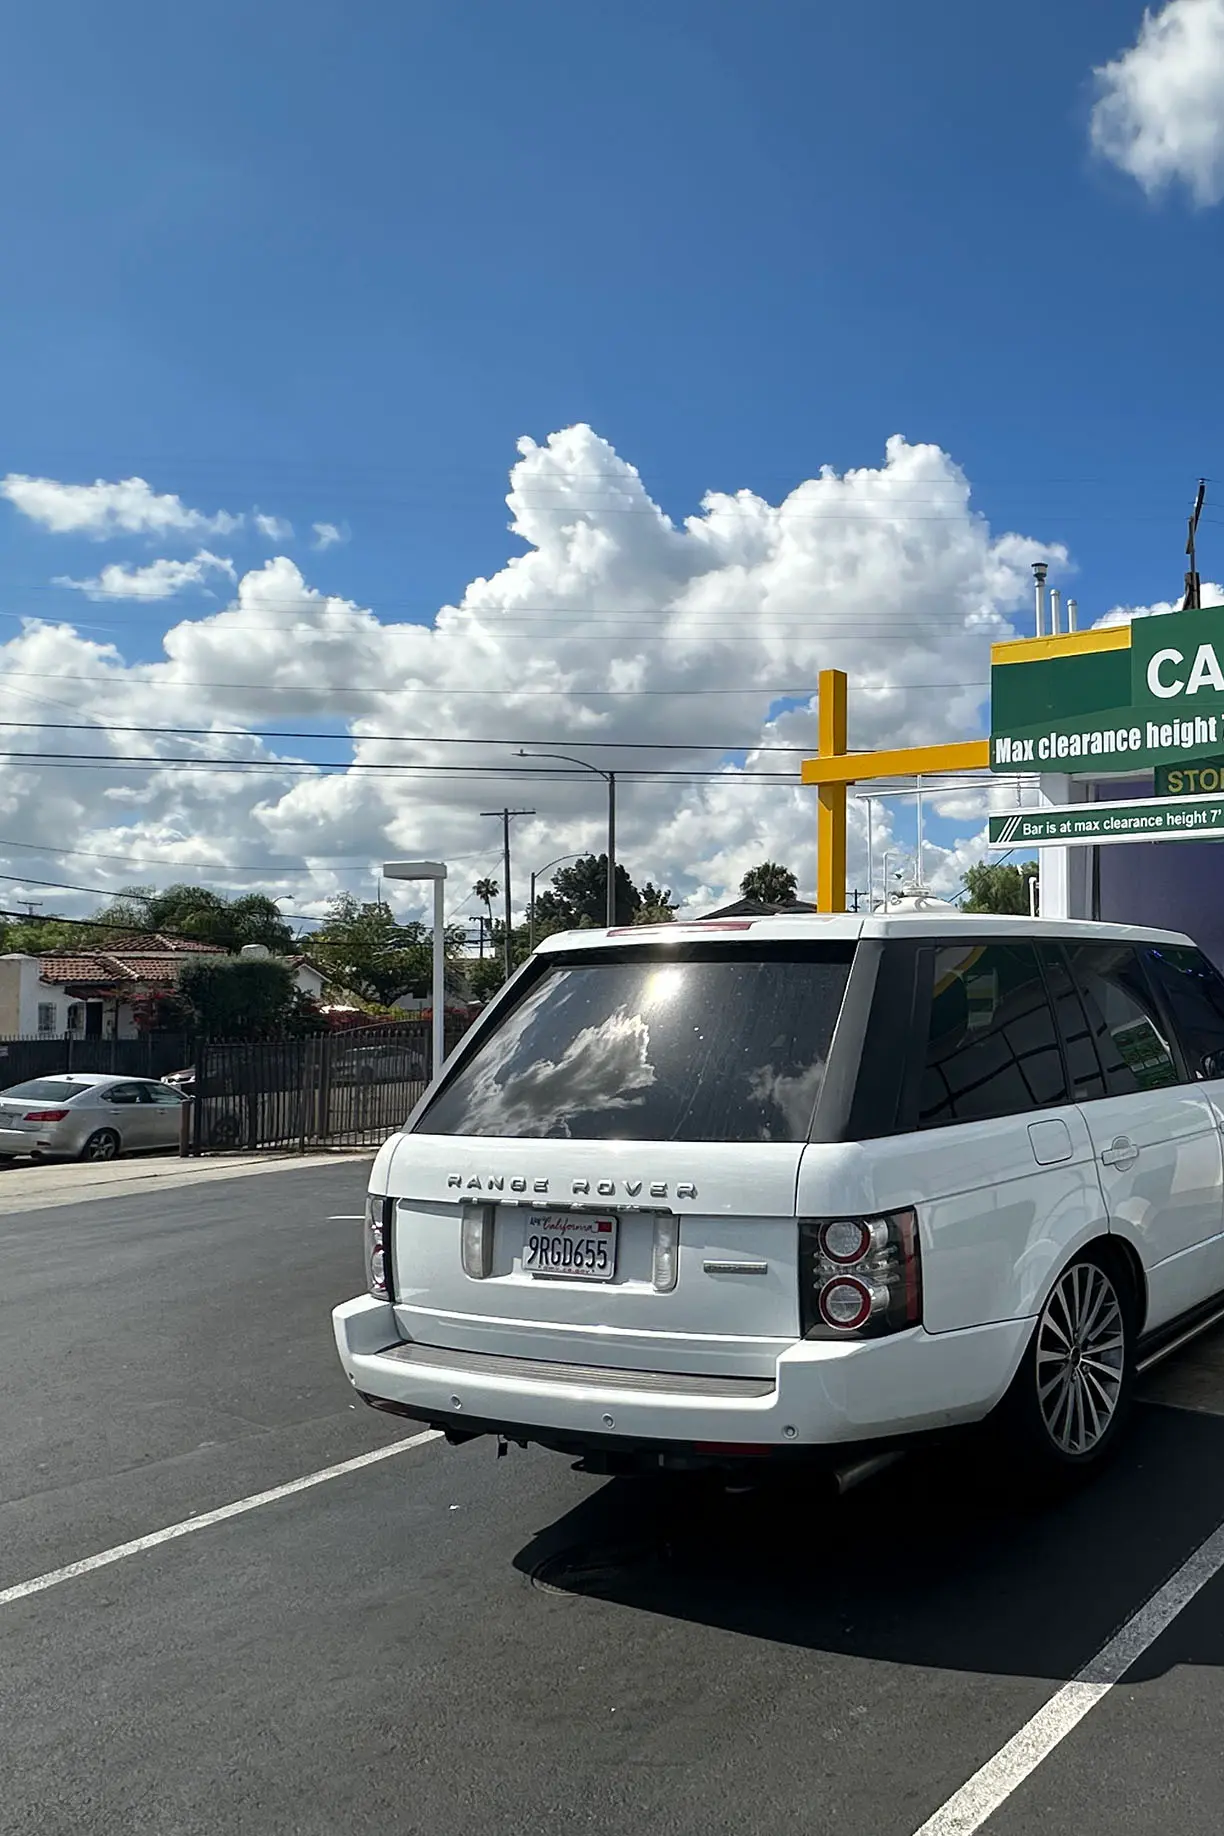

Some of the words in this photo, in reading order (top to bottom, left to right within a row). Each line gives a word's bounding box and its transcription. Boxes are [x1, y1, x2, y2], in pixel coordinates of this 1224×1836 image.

[995, 737, 1034, 764] Max
[1039, 727, 1141, 760] clearance
[1146, 716, 1217, 749] height
[1022, 822, 1044, 836] Bar
[1046, 820, 1056, 834] is
[1059, 820, 1072, 833] at
[1074, 819, 1100, 832] max
[1103, 814, 1163, 830] clearance
[1166, 810, 1207, 828] height
[447, 1172, 551, 1193] RANGE
[572, 1178, 699, 1200] ROVER
[543, 1217, 593, 1235] California
[527, 1235, 608, 1269] 9RGD655
